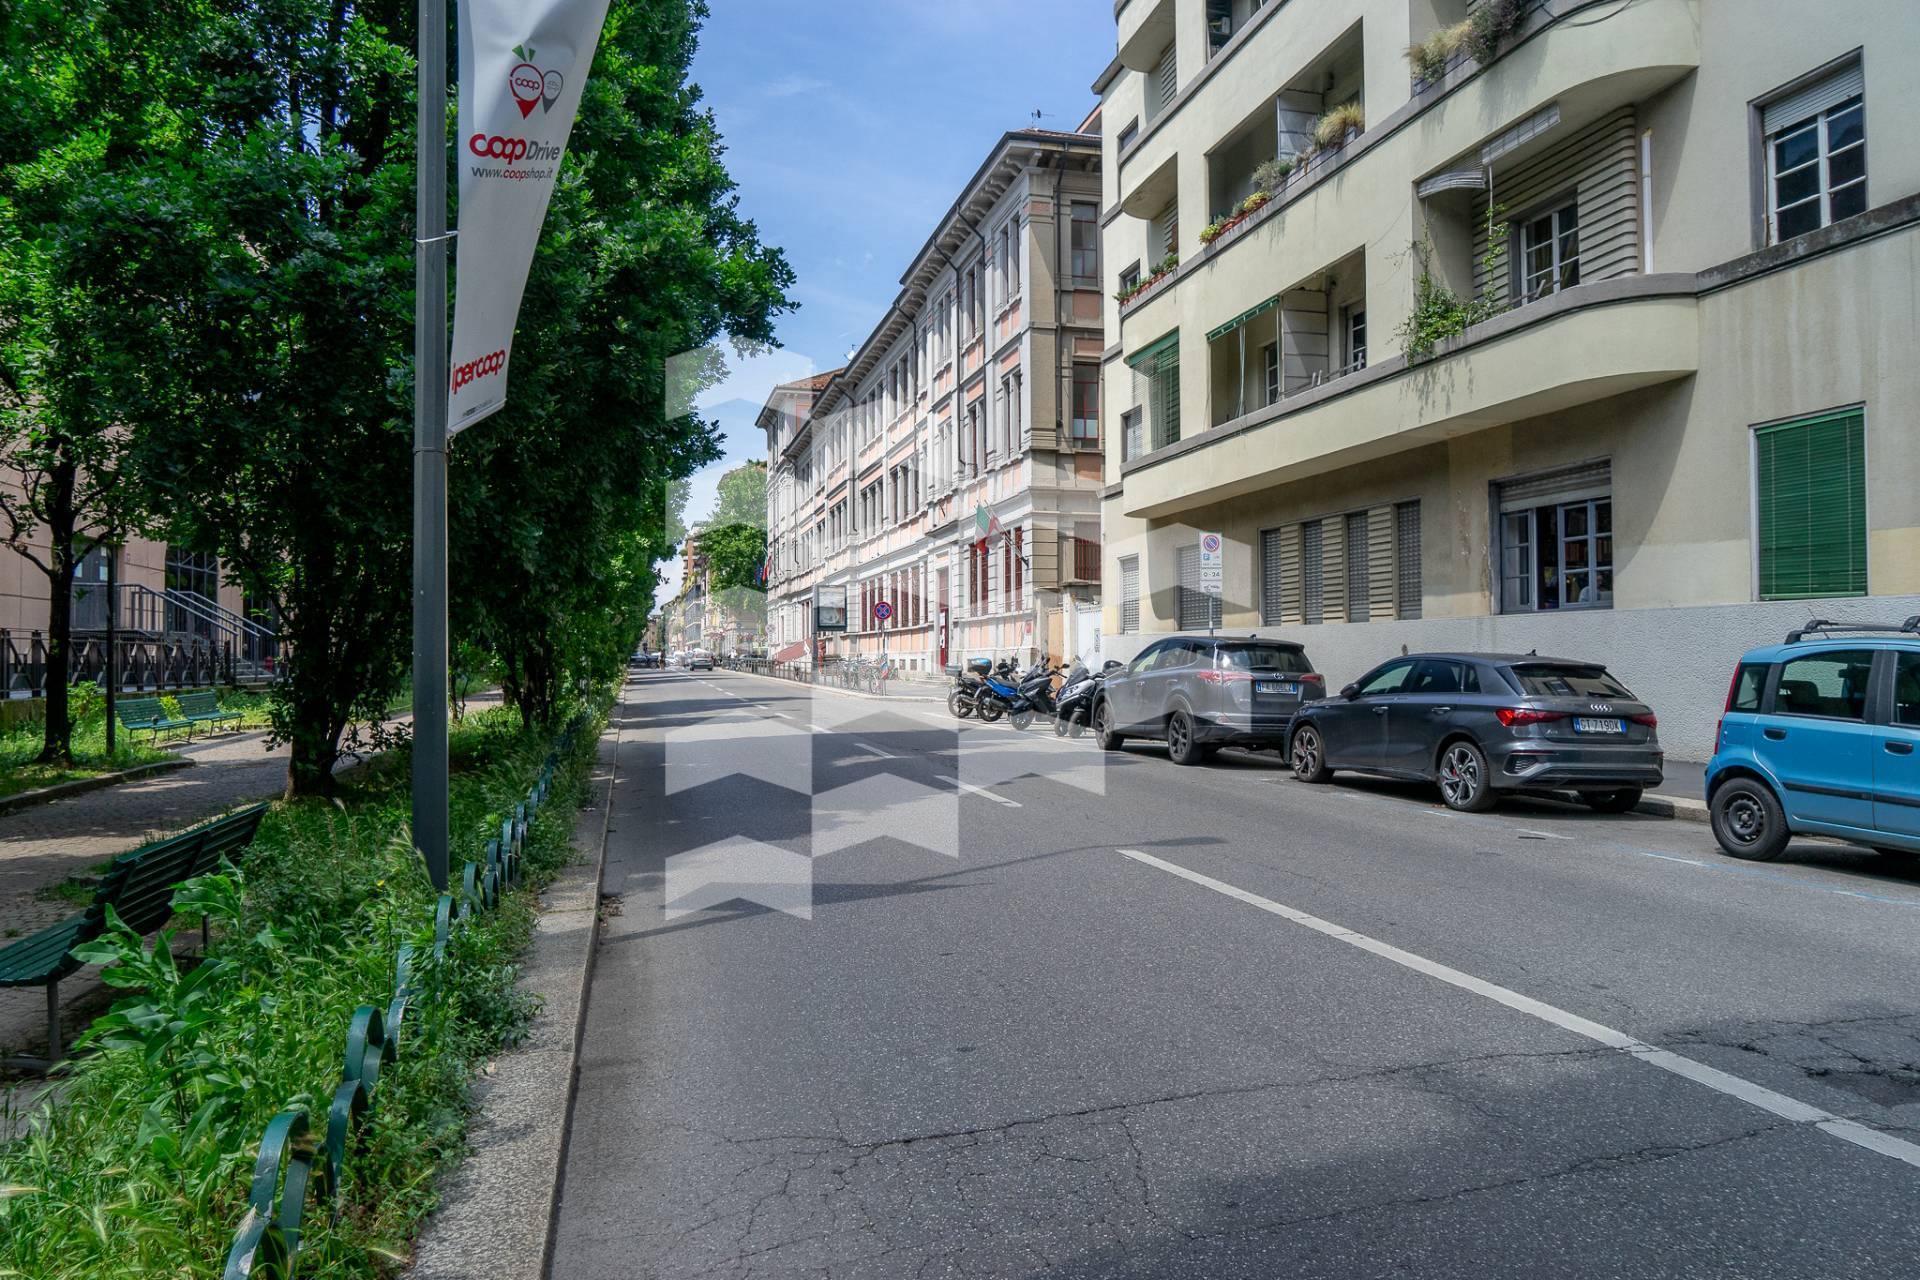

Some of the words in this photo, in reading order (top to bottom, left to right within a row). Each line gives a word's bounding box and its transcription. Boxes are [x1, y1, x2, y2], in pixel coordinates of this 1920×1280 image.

[514, 77, 540, 91] coop
[525, 141, 560, 161] Drive
[471, 166, 554, 181] www.coopshop.it
[452, 349, 506, 394] ipercoop
